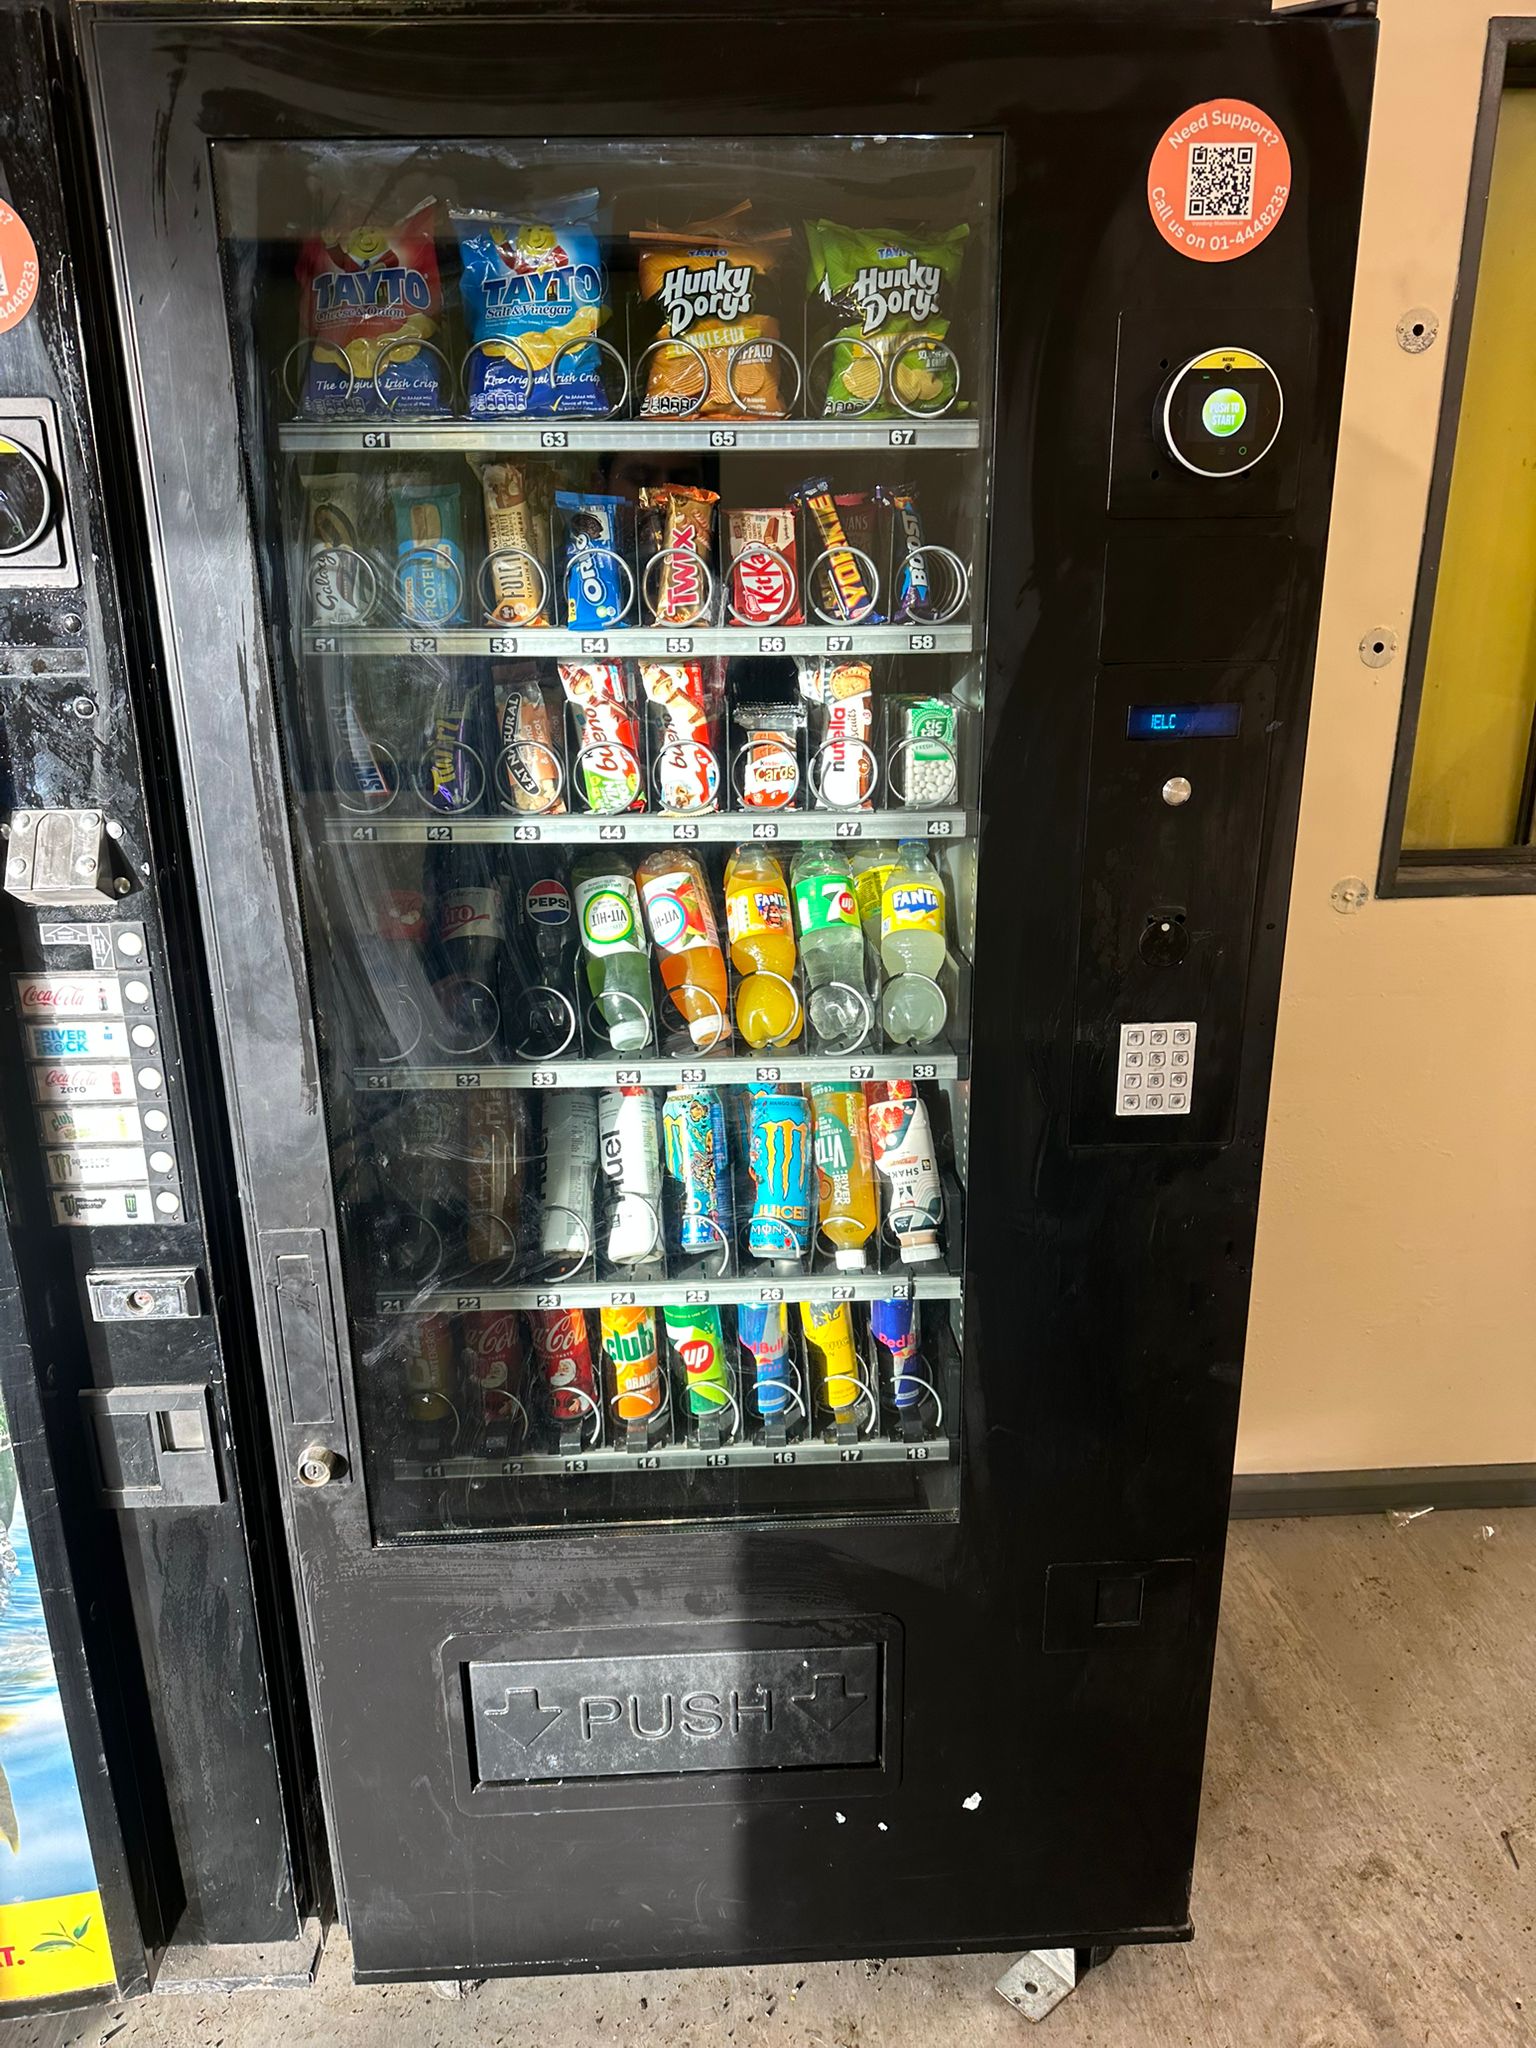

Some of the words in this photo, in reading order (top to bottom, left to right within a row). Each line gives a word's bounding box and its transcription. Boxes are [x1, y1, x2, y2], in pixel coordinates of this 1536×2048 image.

[1168, 112, 1209, 149] Need
[1211, 109, 1280, 147] Support?
[1152, 187, 1174, 222] Call
[1167, 221, 1186, 239] us
[1186, 234, 1206, 249] on
[1209, 185, 1288, 251] 01-4448233
[482, 264, 601, 307] TAYTO
[659, 261, 751, 304] Hunky
[851, 259, 940, 300] Hunky
[312, 267, 431, 309] TAYTO
[670, 293, 751, 337] Dorys
[316, 380, 337, 390] The
[384, 378, 411, 391] Irish
[413, 378, 439, 392] Crisp
[1231, 402, 1240, 413] TO
[1212, 415, 1236, 425] START
[364, 433, 386, 447] 61
[543, 433, 566, 446] 63
[712, 432, 735, 446] 65
[891, 431, 914, 444] 67
[576, 533, 603, 603] ORO
[314, 552, 337, 611] Galaxy
[741, 548, 783, 604] KitKa
[421, 557, 440, 618] PROTEIN
[315, 639, 336, 652] 51
[413, 639, 436, 651] 52
[492, 640, 514, 652] 53
[583, 640, 606, 652] 54
[668, 638, 691, 651] 55
[761, 637, 784, 651] 56
[829, 637, 850, 651] 57
[911, 635, 933, 649] 58
[925, 719, 944, 729] tic
[504, 698, 520, 767] NTURAL
[920, 728, 942, 737] tac
[585, 707, 618, 772] bueno
[831, 706, 845, 772] nutella
[514, 767, 536, 792] EAT
[353, 828, 374, 839] 41
[428, 828, 450, 839] 42
[516, 827, 536, 839] 43
[601, 827, 622, 838] 44
[674, 825, 696, 838] 45
[754, 825, 776, 837] 46
[838, 823, 858, 836] 47
[928, 823, 950, 834] 48
[529, 897, 569, 909] PEPSI
[40, 1030, 87, 1041] RIVER
[683, 1069, 704, 1082] 35
[758, 1068, 779, 1080] 36
[852, 1066, 871, 1078] 37
[914, 1065, 935, 1077] 38
[369, 1076, 388, 1088] 31
[457, 1075, 478, 1087] 32
[532, 1073, 554, 1085] 33
[618, 1072, 639, 1083] 34
[60, 1085, 87, 1094] zero
[604, 1130, 626, 1201] Huel
[840, 1173, 851, 1205] RIVER
[613, 1293, 632, 1304] 24
[688, 1291, 707, 1302] 25
[762, 1288, 781, 1299] 26
[834, 1287, 853, 1298] 27
[460, 1298, 478, 1308] 22
[539, 1296, 558, 1307] 23
[606, 1322, 653, 1361] club
[879, 1332, 905, 1347] Red
[775, 1453, 793, 1463] 16
[842, 1450, 859, 1460] 17
[908, 1448, 926, 1458] 18
[567, 1461, 585, 1471] 13
[639, 1458, 657, 1468] 14
[709, 1455, 726, 1466] 15
[504, 1464, 522, 1474] 12
[578, 1688, 773, 1742] PUSH
